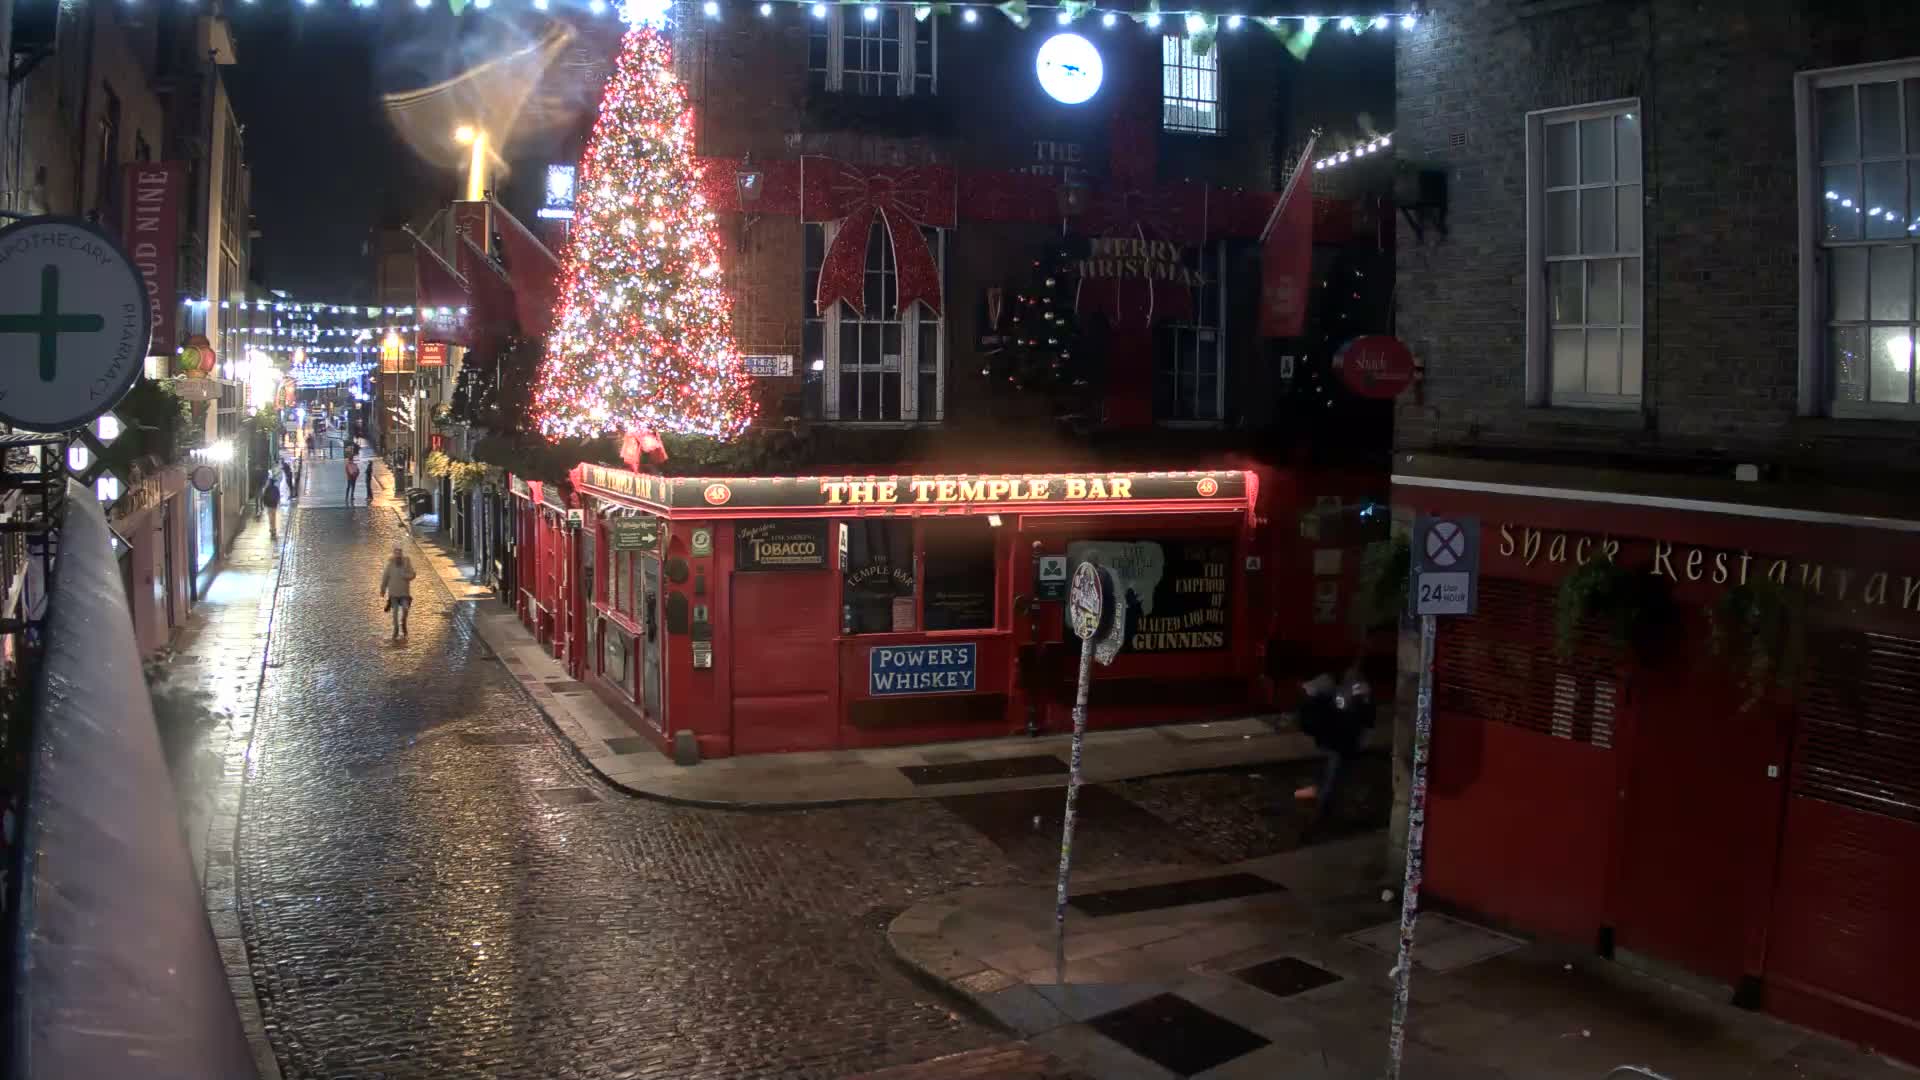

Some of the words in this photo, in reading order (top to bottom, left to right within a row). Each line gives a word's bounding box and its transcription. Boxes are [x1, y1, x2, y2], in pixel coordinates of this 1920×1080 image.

[135, 170, 169, 232] NINE
[1088, 238, 1182, 262] MERRY
[1078, 259, 1206, 287] HRISTMAS
[822, 481, 898, 504] THE
[910, 478, 1050, 502] TEMPLE
[1064, 477, 1133, 500] BAR
[750, 538, 816, 561] TOBACCO
[847, 566, 889, 587] TEMPLE
[893, 568, 913, 587] BAR
[1422, 584, 1442, 602] 24
[1132, 631, 1224, 649] GUINNESS
[880, 648, 968, 668] POWER'S
[873, 670, 972, 690] WHISKEY
